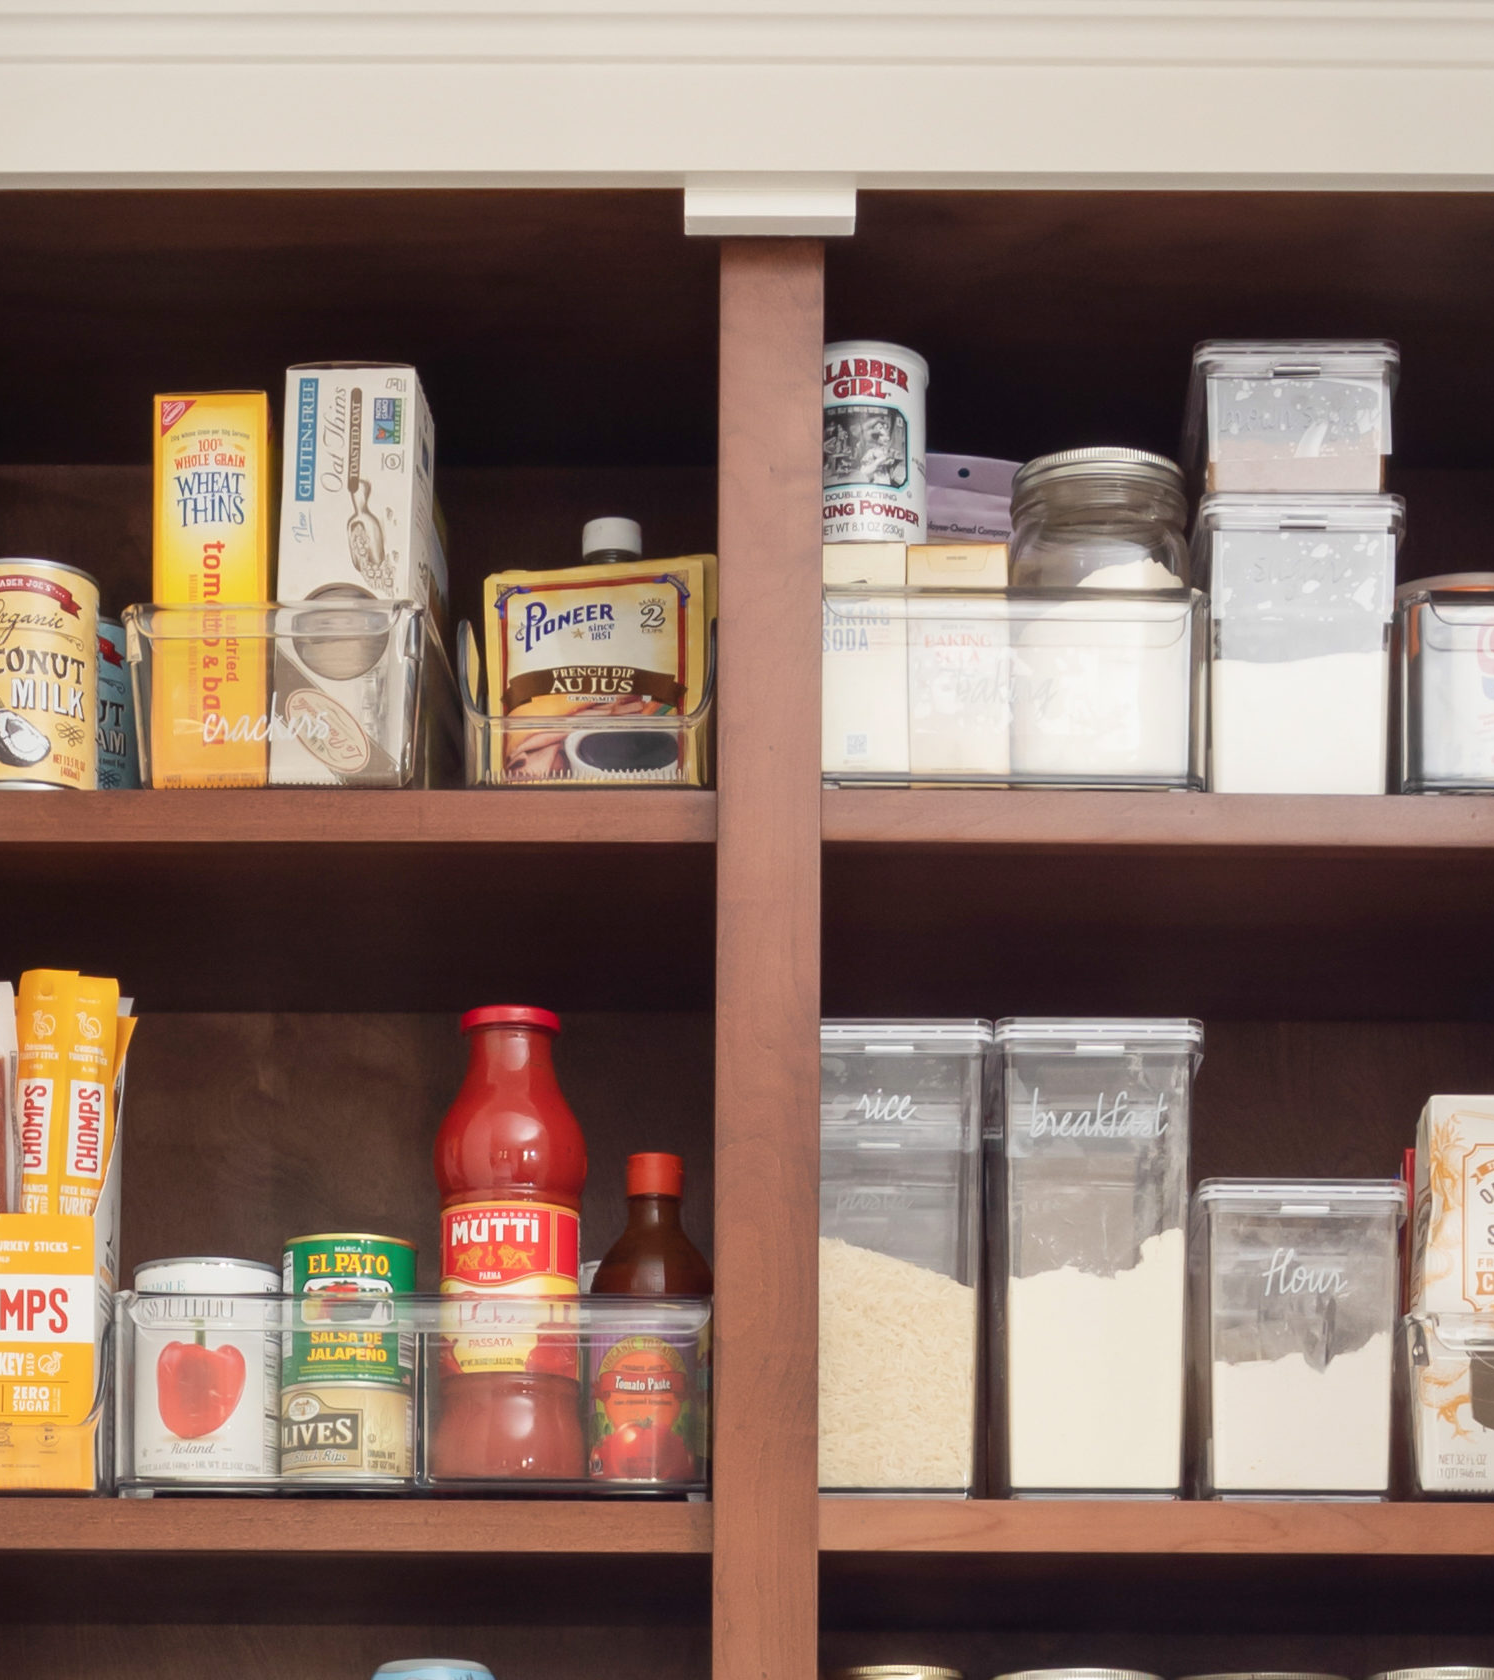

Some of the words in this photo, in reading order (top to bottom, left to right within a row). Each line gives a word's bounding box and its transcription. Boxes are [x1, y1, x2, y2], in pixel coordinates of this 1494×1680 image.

[823, 358, 909, 393] LABBER
[833, 378, 887, 399] GIRL
[323, 386, 347, 448] Thins
[351, 401, 361, 427] OAT
[198, 439, 223, 452] 100%
[299, 382, 315, 497] GLUTEN-FREE
[174, 453, 210, 470] WHOLE
[215, 453, 246, 468] GRAIN
[350, 429, 360, 478] TOASTED
[320, 451, 345, 493] Oat
[173, 471, 246, 497] WHEAT
[825, 491, 862, 502] DOUBLE
[865, 491, 898, 502] ACTING
[823, 503, 855, 520] KING
[859, 500, 920, 528] POWDER
[823, 524, 835, 537] ET
[835, 523, 850, 534] WT
[852, 522, 865, 533] 8.1
[866, 522, 882, 533] OZ
[25, 577, 53, 592] JOE'S
[640, 604, 666, 628] 2
[588, 622, 615, 633] since
[591, 631, 612, 641] 1851
[822, 628, 869, 652] SODA
[924, 633, 992, 648] BAKING
[552, 667, 607, 679] FRENCH
[611, 667, 635, 679] DIP
[550, 679, 583, 694] AU
[590, 679, 634, 694] JUS
[10, 677, 85, 722] MILK
[204, 691, 331, 743] crackers
[856, 1088, 917, 1121] rice
[1029, 1087, 1169, 1138] breakfast
[22, 1085, 47, 1168] CHOMPS
[74, 1088, 101, 1173] CHOMPS
[451, 1218, 539, 1247] MUTTI
[33, 1241, 69, 1253] STICKS
[308, 1254, 332, 1274] EL
[334, 1253, 389, 1276] PATO
[1262, 1248, 1347, 1296] flour
[478, 1271, 502, 1281] PARMA
[310, 1331, 359, 1345] SALSA
[362, 1331, 383, 1345] DE
[468, 1337, 514, 1348] PASSATA
[307, 1344, 387, 1362] JALAPEÑO
[13, 1386, 50, 1400] ZERO
[615, 1375, 646, 1392] Tomato
[647, 1377, 671, 1391] Paste
[13, 1400, 50, 1412] SUGAR
[282, 1418, 353, 1449] LIVES
[171, 1442, 215, 1455] Roland
[1438, 1454, 1455, 1465] NET
[1455, 1454, 1465, 1465] 32
